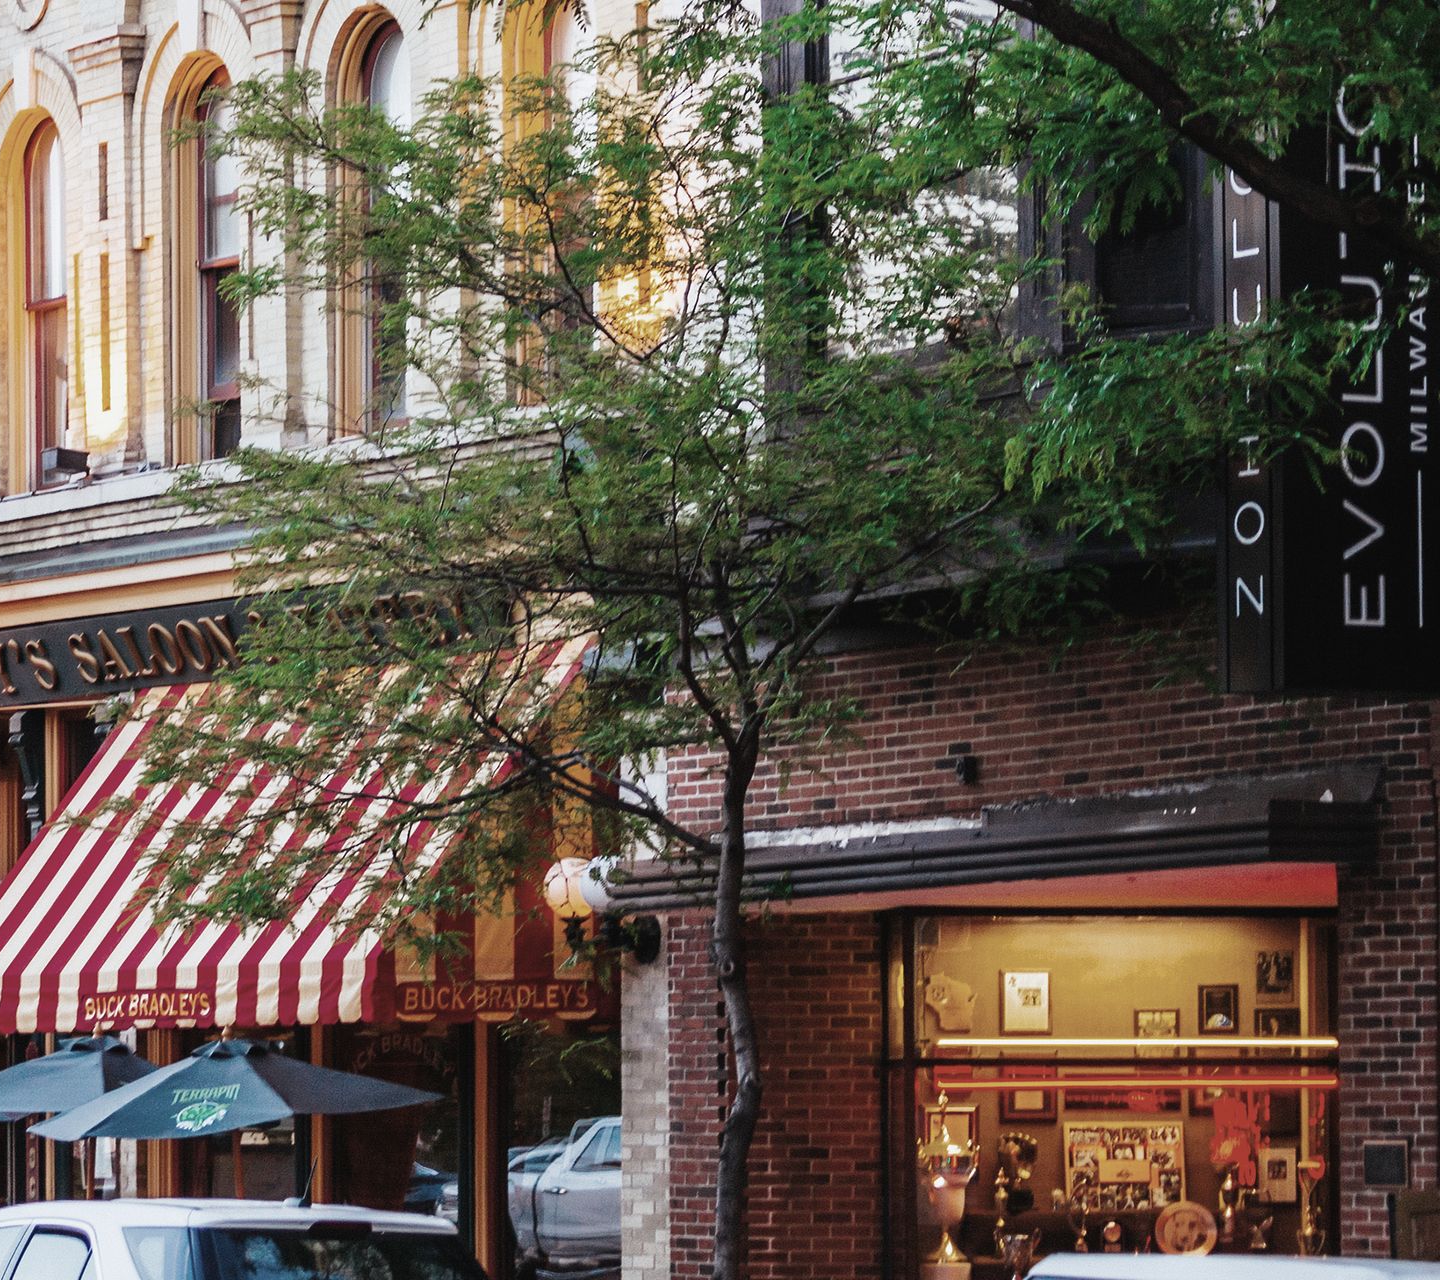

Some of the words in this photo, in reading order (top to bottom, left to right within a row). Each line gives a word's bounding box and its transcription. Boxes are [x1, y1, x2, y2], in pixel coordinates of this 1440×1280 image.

[67, 616, 241, 685] SALOON
[84, 994, 126, 1021] BUCK
[128, 991, 211, 1017] BRADLEY'S
[404, 987, 465, 1011] BUCK
[171, 1084, 241, 1105] TERRAPIN
